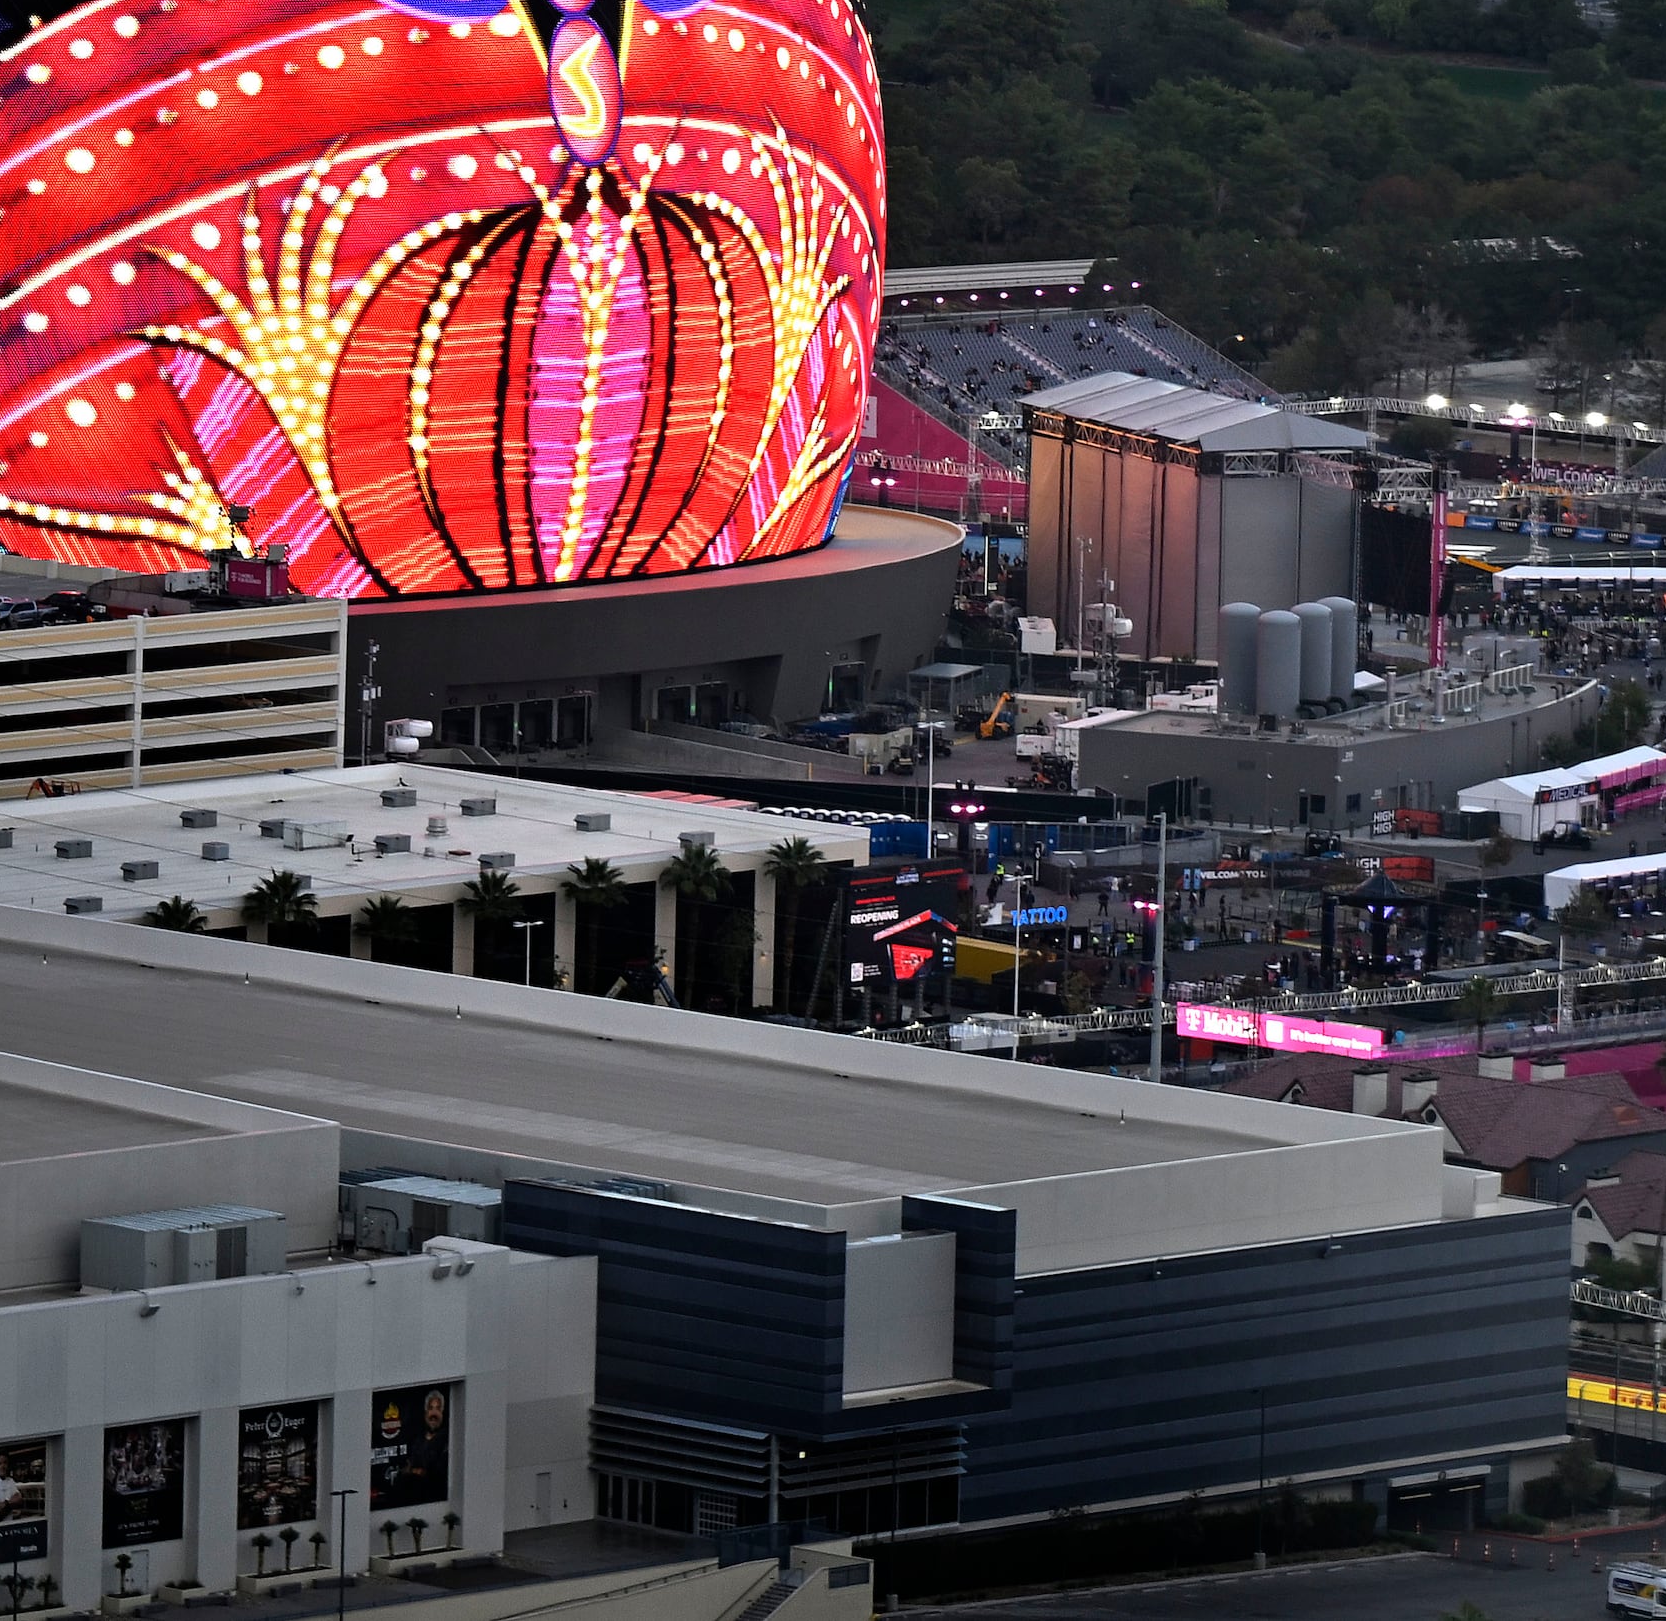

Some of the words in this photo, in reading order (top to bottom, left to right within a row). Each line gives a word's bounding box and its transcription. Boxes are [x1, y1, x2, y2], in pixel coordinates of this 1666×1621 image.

[1549, 784, 1588, 803] MEDICAL
[1373, 810, 1395, 823] HIGH
[1199, 869, 1241, 880] WELCOM
[1245, 869, 1259, 878] TO
[850, 910, 899, 924] REOPENING
[1011, 905, 1068, 926] TATTOO
